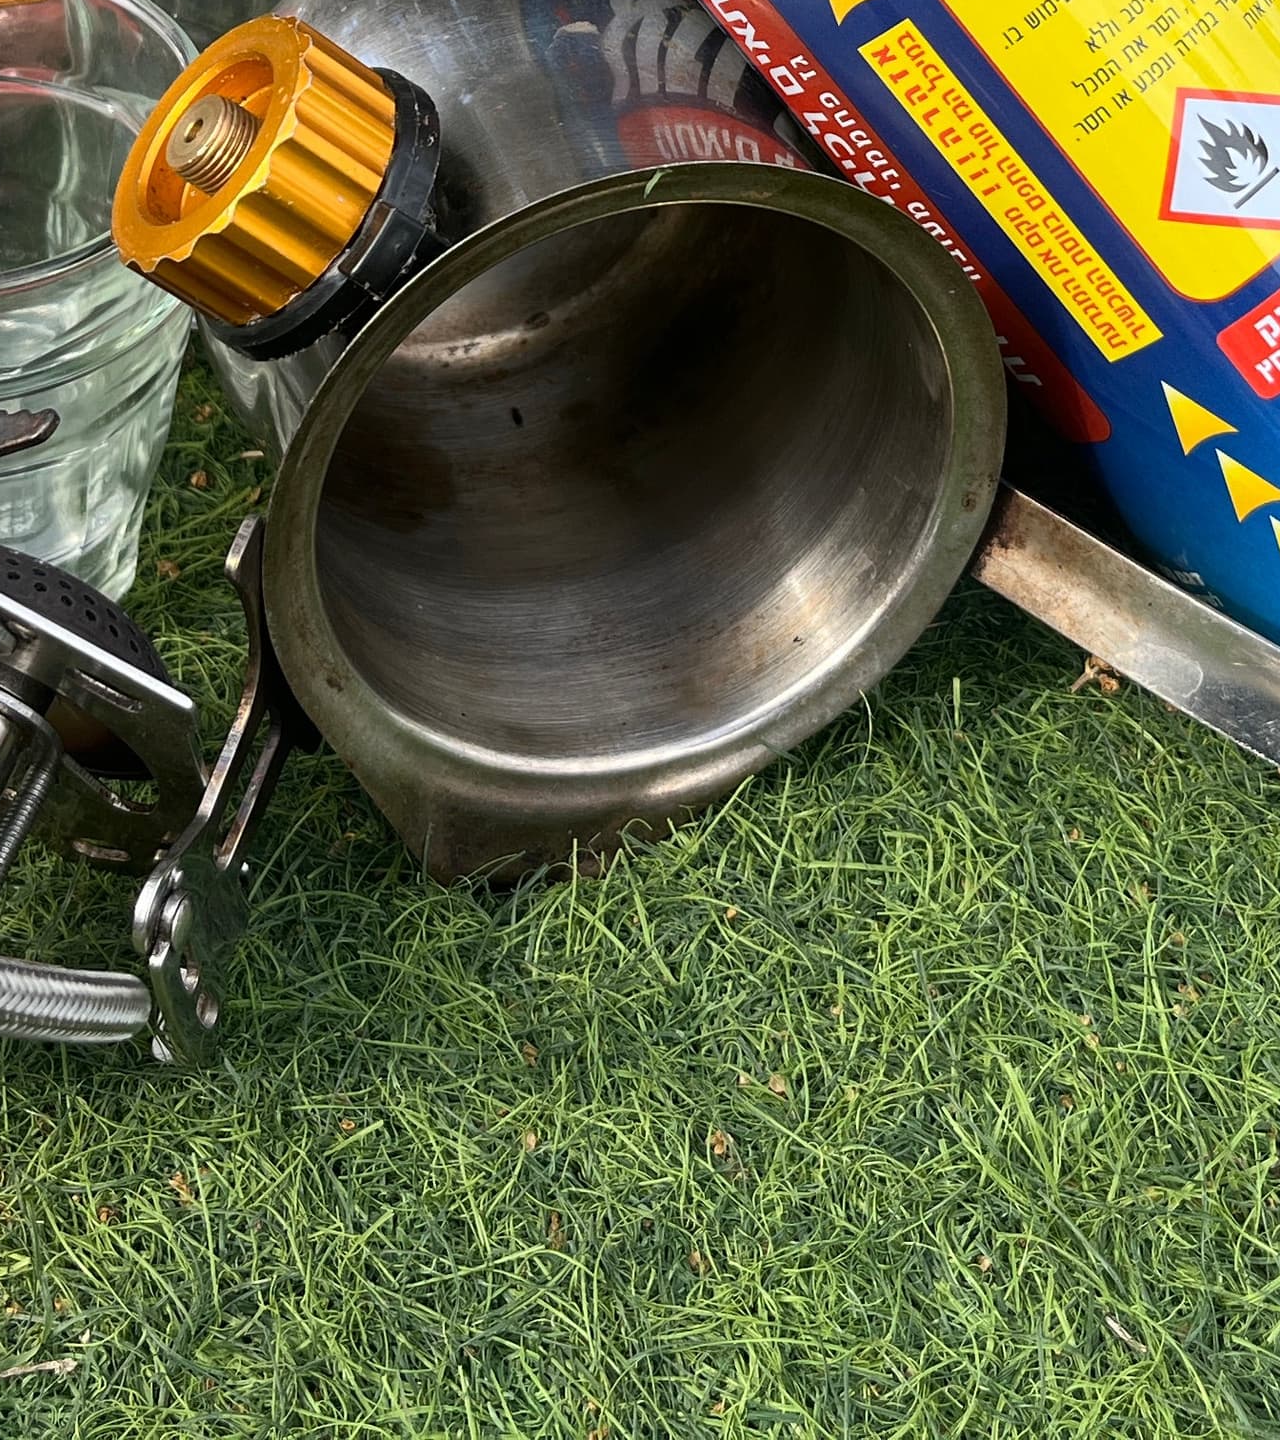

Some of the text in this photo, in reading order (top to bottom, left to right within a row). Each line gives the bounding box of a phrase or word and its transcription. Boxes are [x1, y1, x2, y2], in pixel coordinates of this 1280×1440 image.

[1002, 26, 1025, 50] בו.
[1083, 19, 1121, 54] וללא
[1146, 6, 1181, 37] הסר
[1173, 11, 1220, 57] במידה
[1121, 35, 1149, 64] את
[1070, 59, 1122, 97] המכל
[1132, 51, 1176, 94] ונפגע
[1111, 88, 1134, 110] או
[790, 55, 817, 81] גז
[819, 92, 901, 190] פחממני
[1073, 105, 1112, 142] חסר.
[804, 112, 896, 205] לכיר
[896, 24, 1154, 340] במיכל הגז מול התפס בווסת המכשיר
[1004, 206, 1045, 249] מקם
[1037, 248, 1070, 277] את
[1061, 277, 1128, 357] המגרעת
